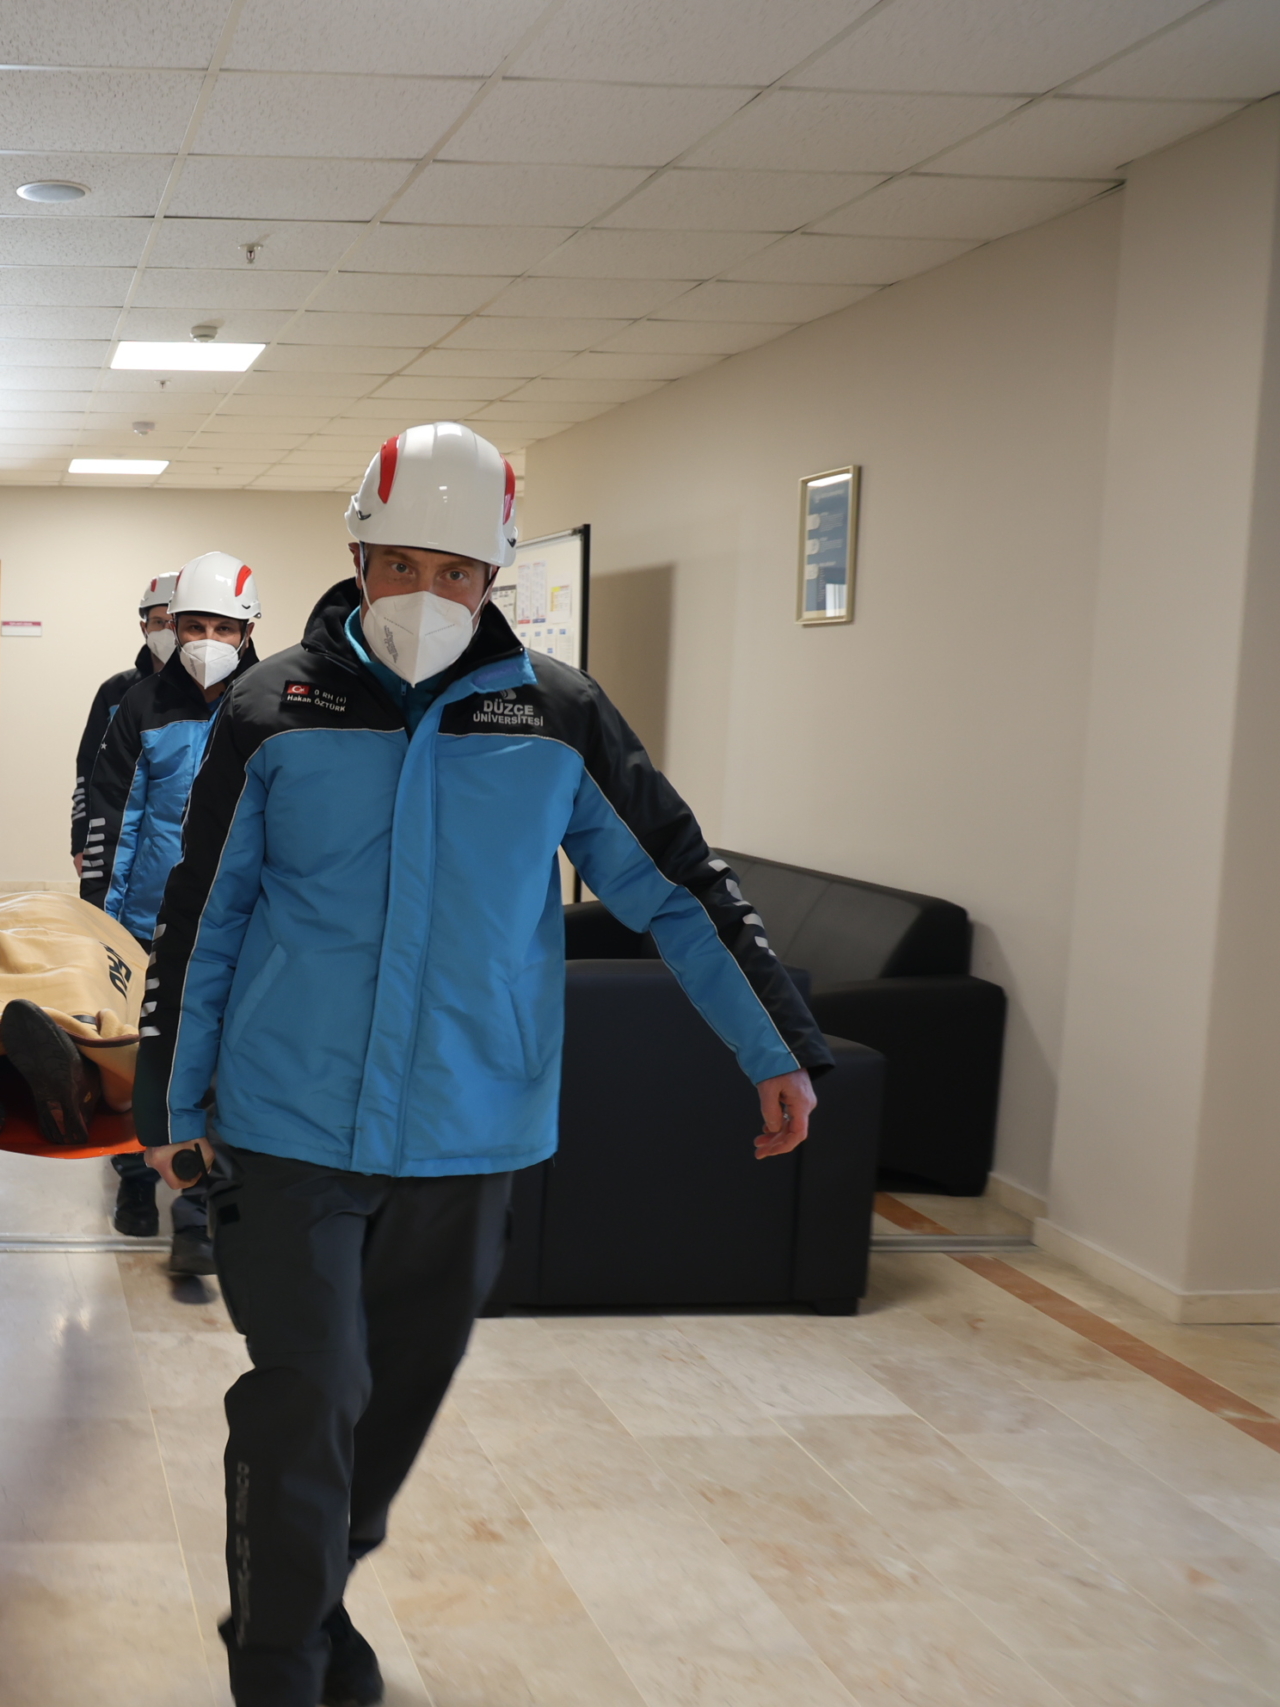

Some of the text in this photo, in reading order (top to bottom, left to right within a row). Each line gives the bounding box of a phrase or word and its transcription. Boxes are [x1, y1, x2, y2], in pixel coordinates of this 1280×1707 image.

[287, 694, 346, 712] Hakan ÖZTÜRK
[322, 691, 333, 701] RH
[483, 698, 534, 716] DÜZCE
[473, 710, 544, 727] ÜNİVERSİTESİ
